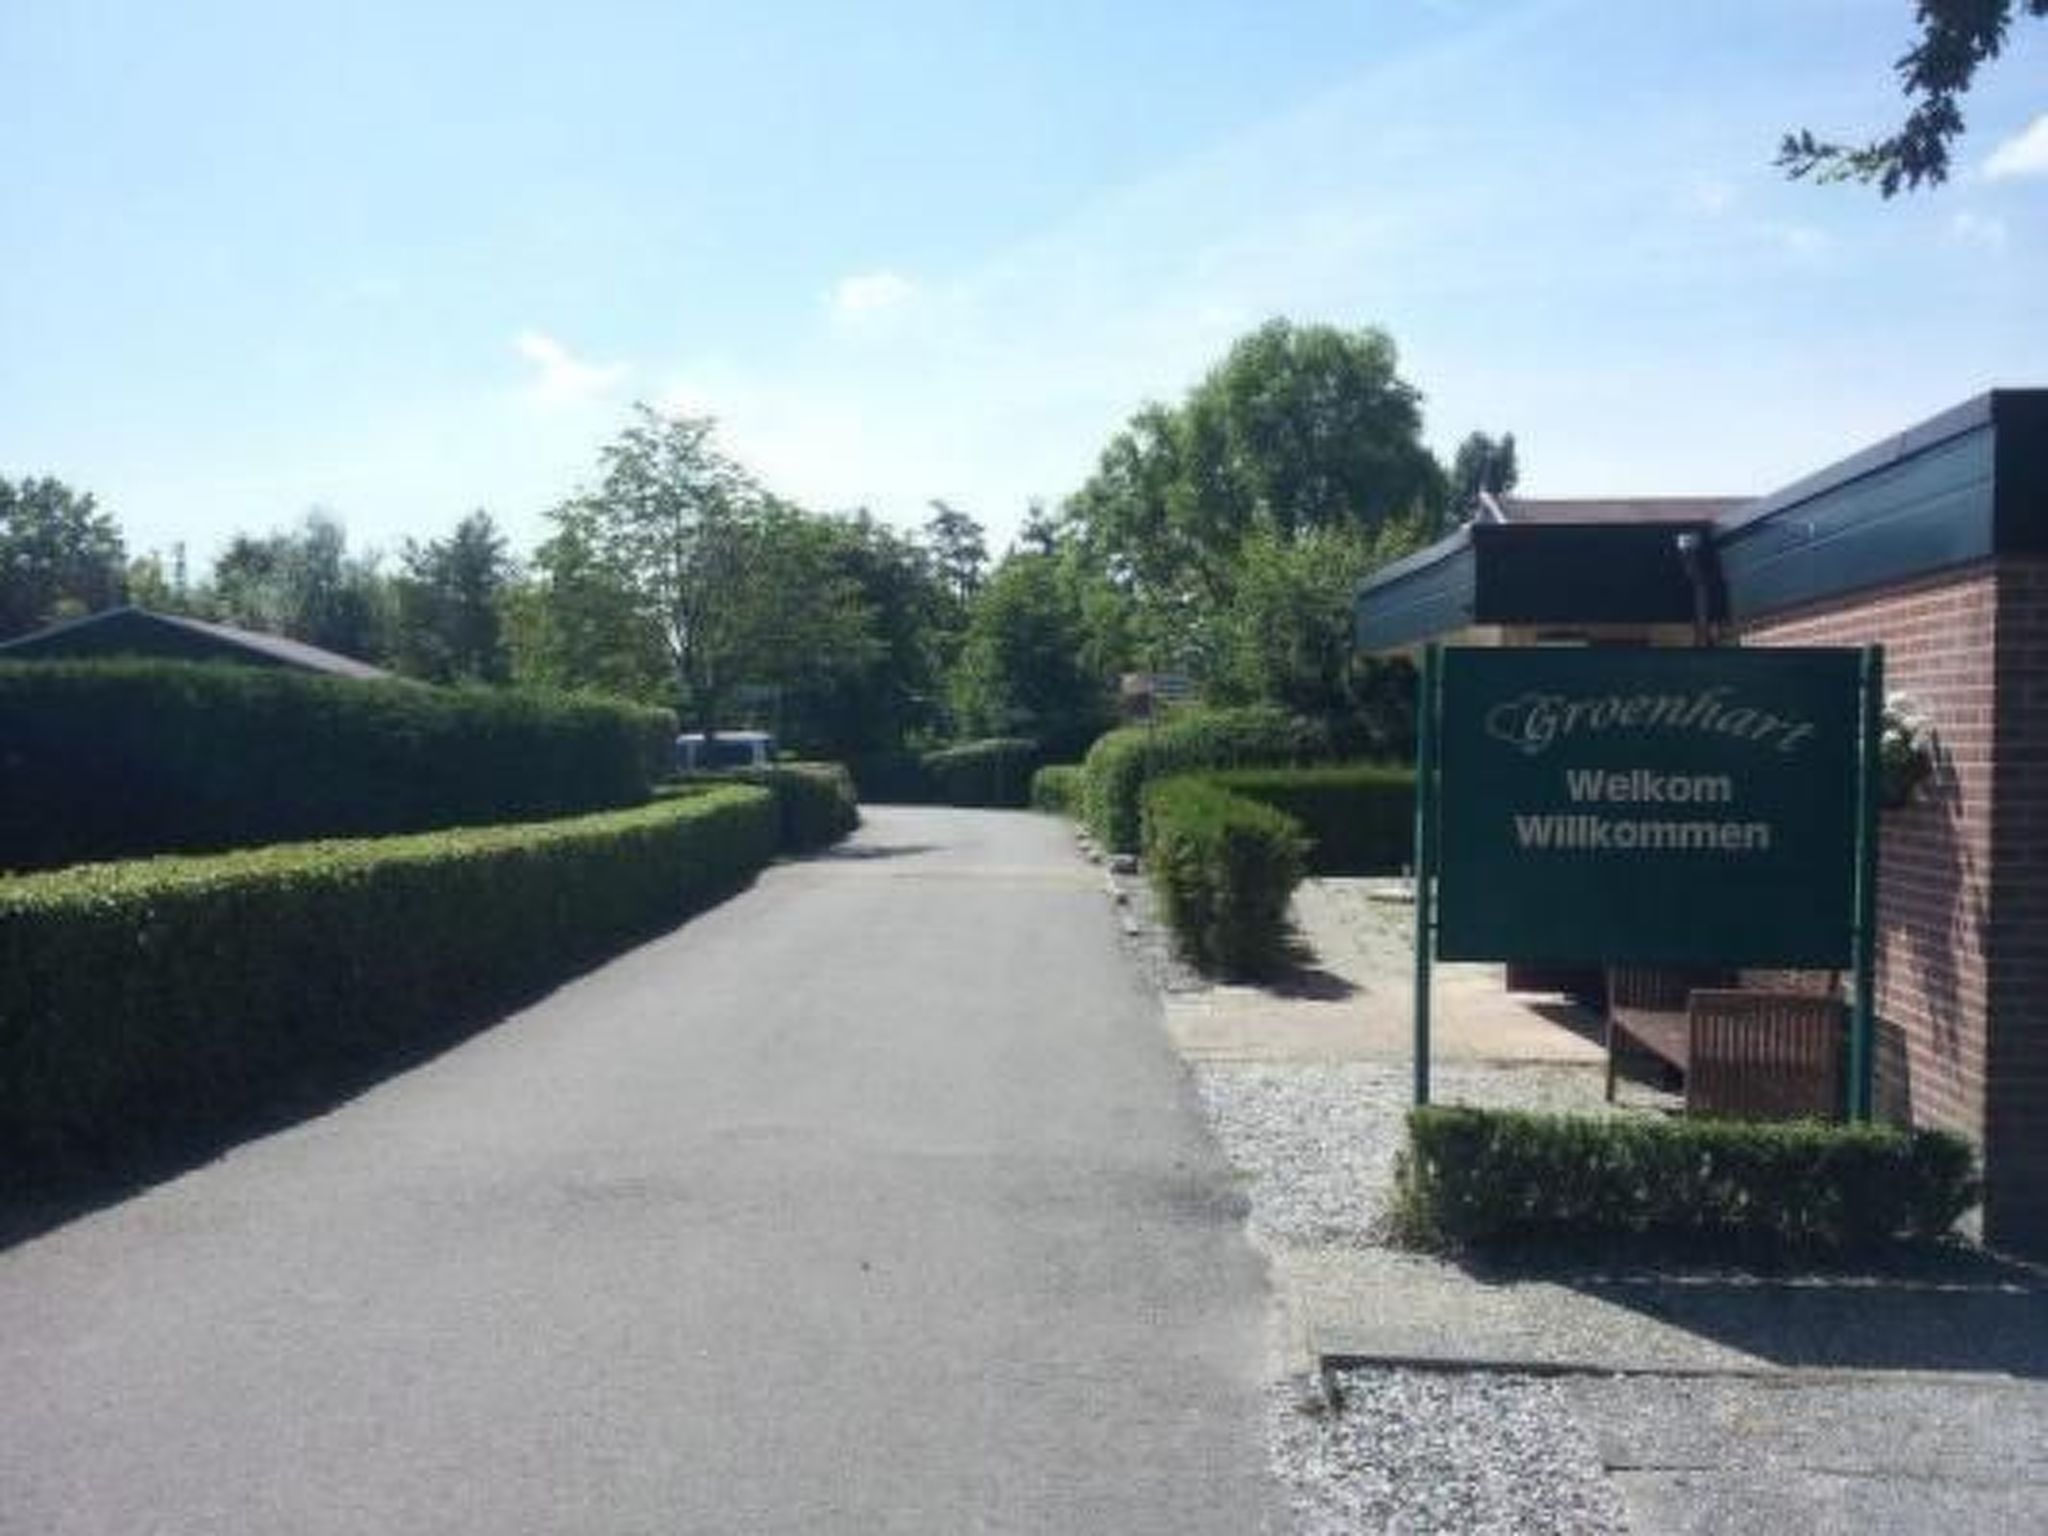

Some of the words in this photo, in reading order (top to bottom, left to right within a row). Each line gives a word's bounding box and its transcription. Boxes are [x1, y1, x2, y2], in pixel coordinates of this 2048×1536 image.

[1486, 684, 1815, 755] Groenhart
[1567, 769, 1732, 802] Welkom
[1514, 815, 1770, 849] Willkommen
